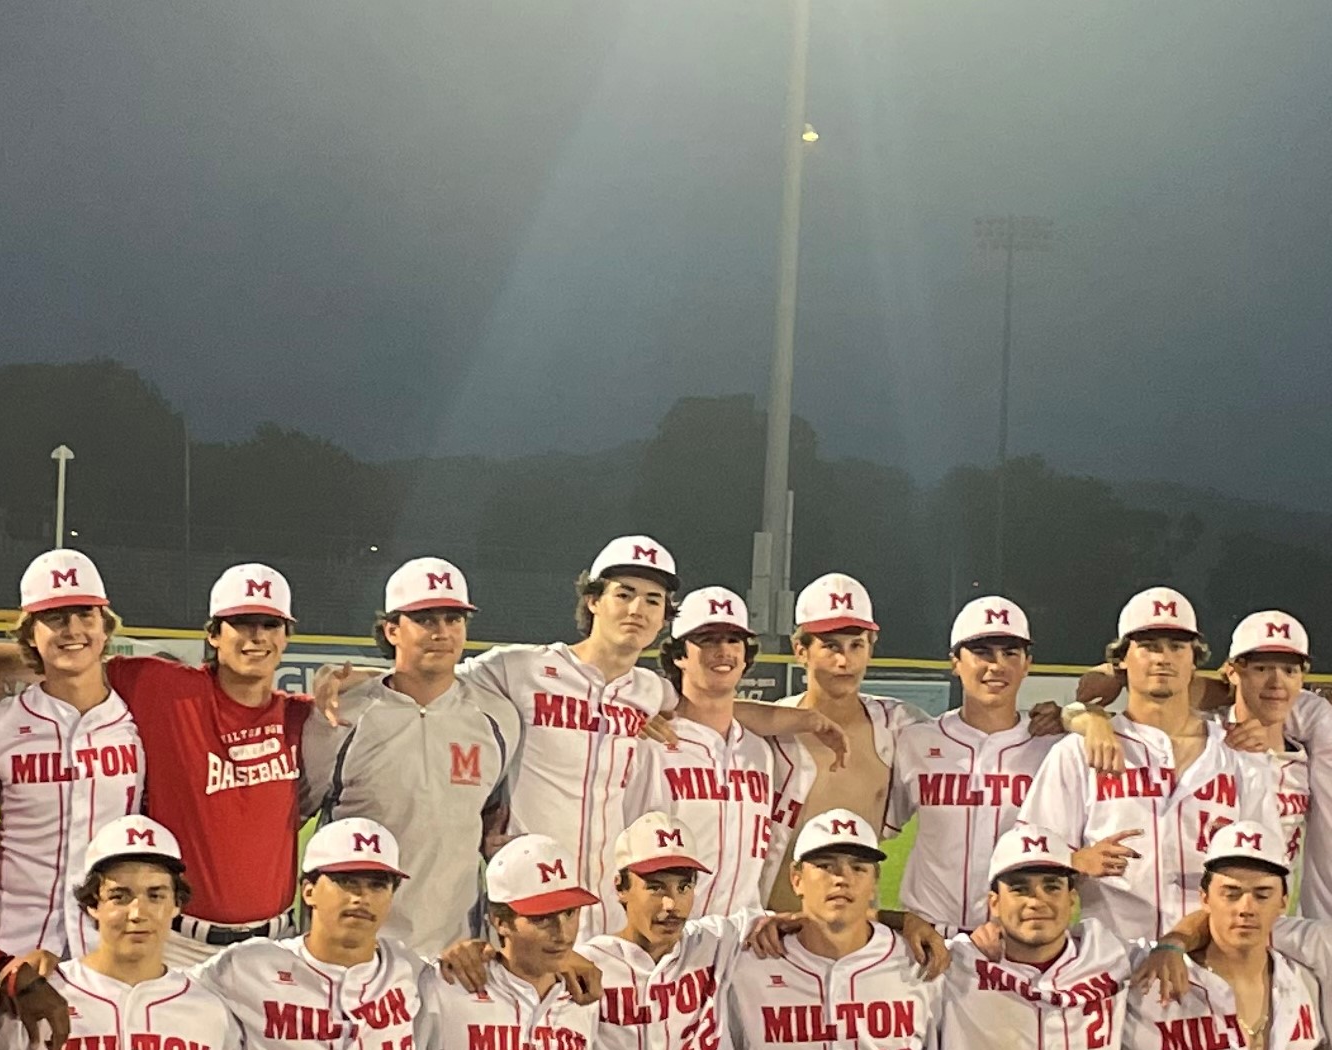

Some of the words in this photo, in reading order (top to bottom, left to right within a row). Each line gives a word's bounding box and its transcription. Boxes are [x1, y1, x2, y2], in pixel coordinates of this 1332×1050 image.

[632, 545, 658, 564] M
[50, 568, 79, 588] M
[426, 572, 453, 590] M
[245, 578, 273, 599] M
[708, 599, 735, 615] M
[829, 592, 854, 610] M
[1153, 601, 1178, 617] M
[984, 608, 1010, 625] M
[1266, 622, 1290, 639] M
[11, 744, 138, 785] MILTON
[206, 745, 300, 796] BASEBALL
[449, 742, 481, 786] M
[918, 773, 1034, 806] MILTO
[125, 827, 156, 847] M
[655, 828, 684, 848] M
[831, 819, 860, 837] M
[352, 832, 382, 853] M
[1021, 835, 1050, 852] M
[1235, 831, 1263, 851] M
[535, 858, 567, 884] M
[600, 966, 717, 1025] ILTON
[263, 987, 412, 1041] MILTON
[761, 1001, 915, 1043] MILTON
